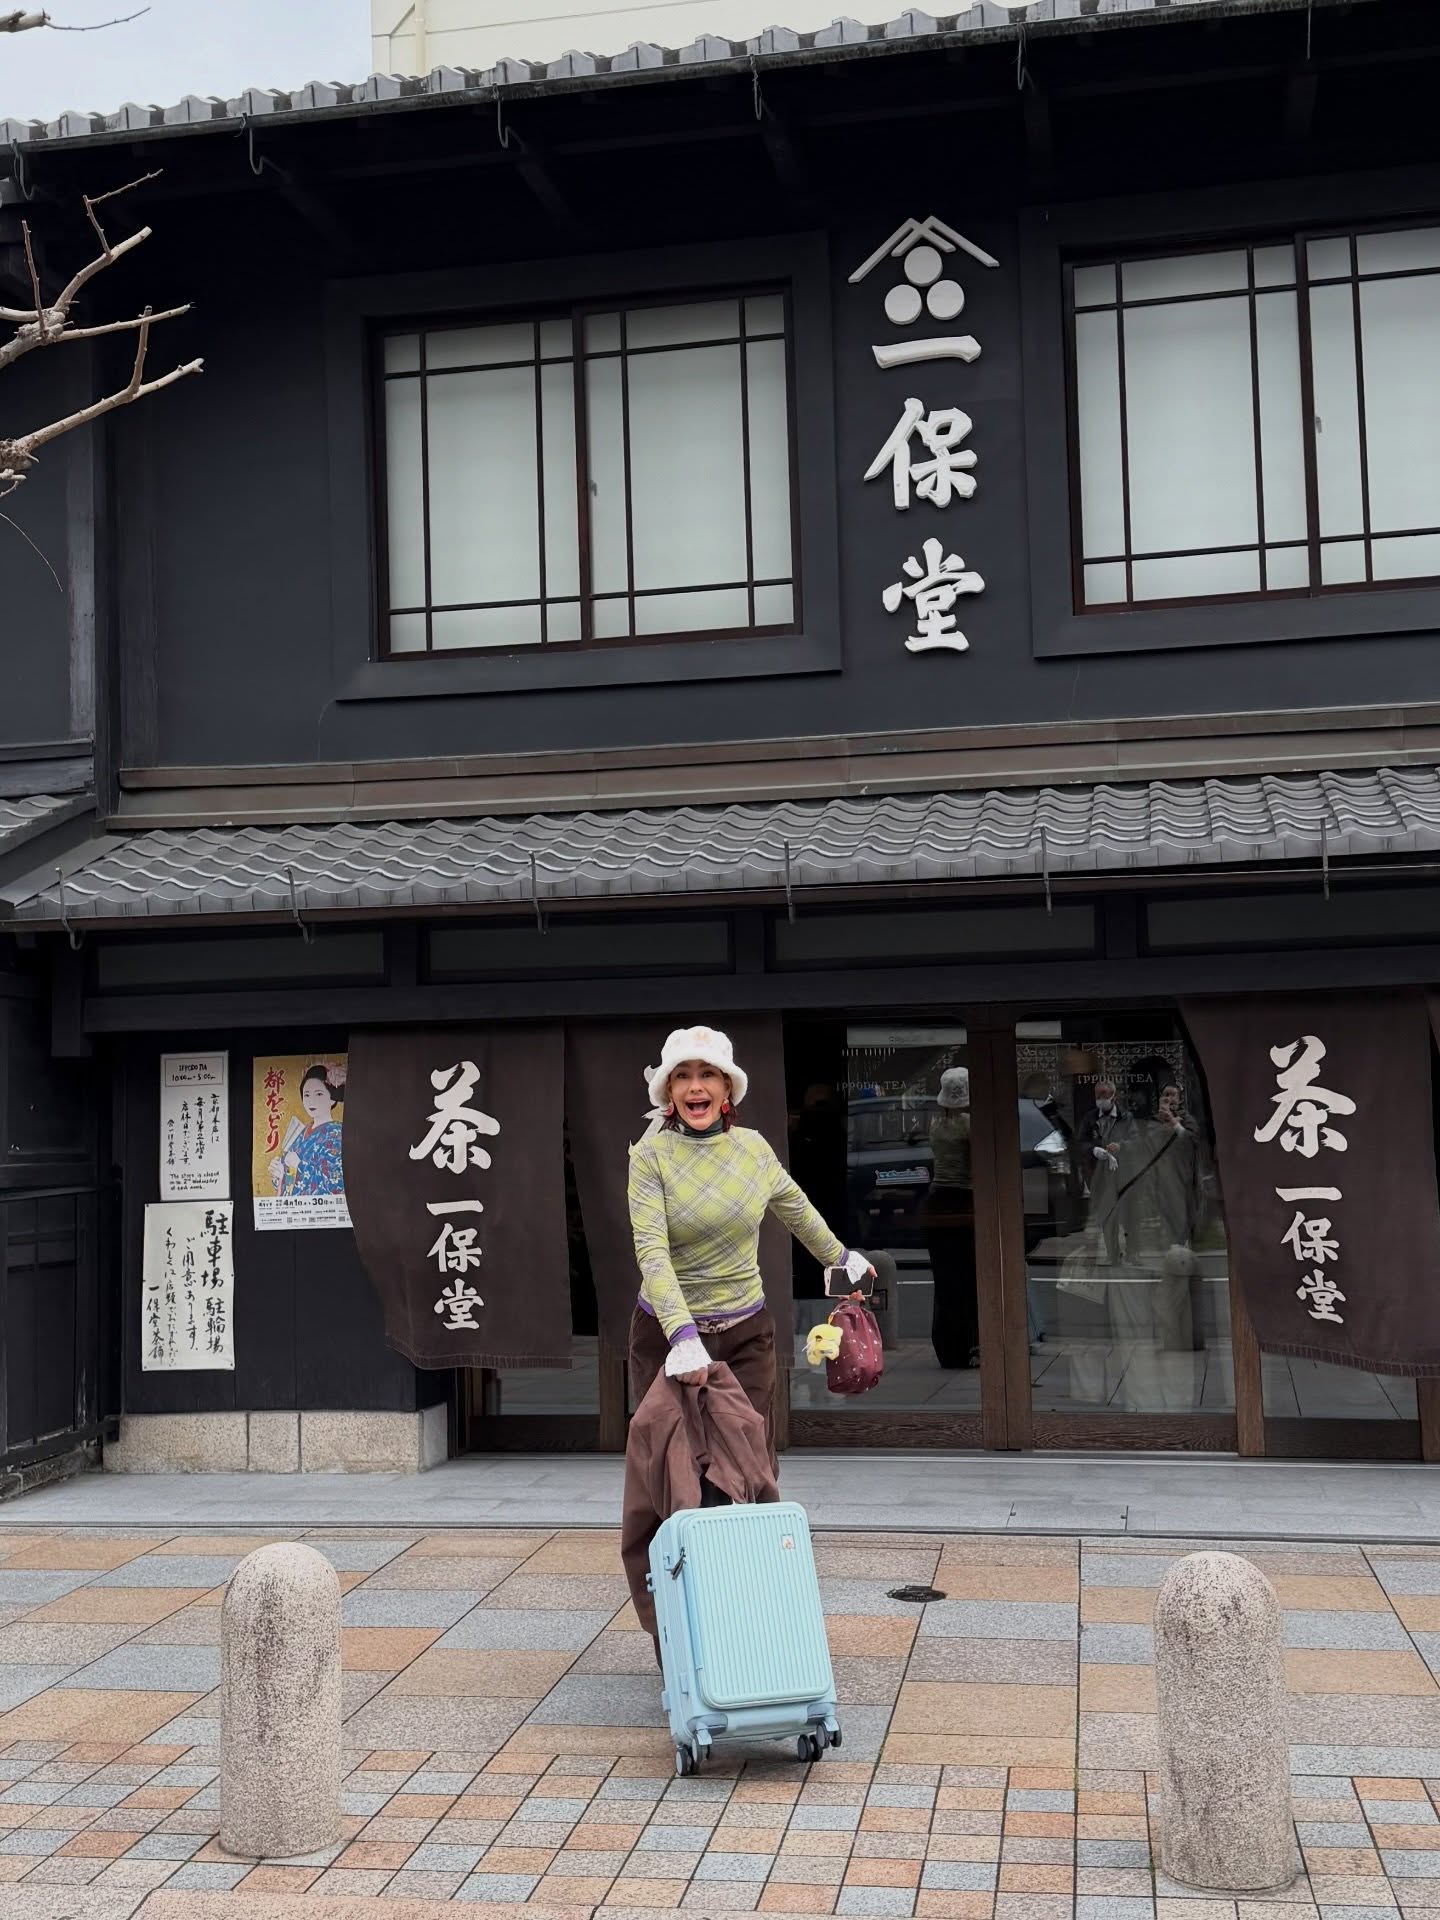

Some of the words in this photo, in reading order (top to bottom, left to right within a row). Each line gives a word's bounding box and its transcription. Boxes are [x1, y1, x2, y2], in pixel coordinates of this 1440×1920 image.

[864, 335, 986, 653] 一保堂
[264, 1067, 286, 1154] 都をどり
[884, 1080, 907, 1090] TEA
[1128, 1073, 1153, 1083] TEA
[201, 1209, 230, 1290] 駐車場
[203, 1297, 226, 1354] 駐輪場
